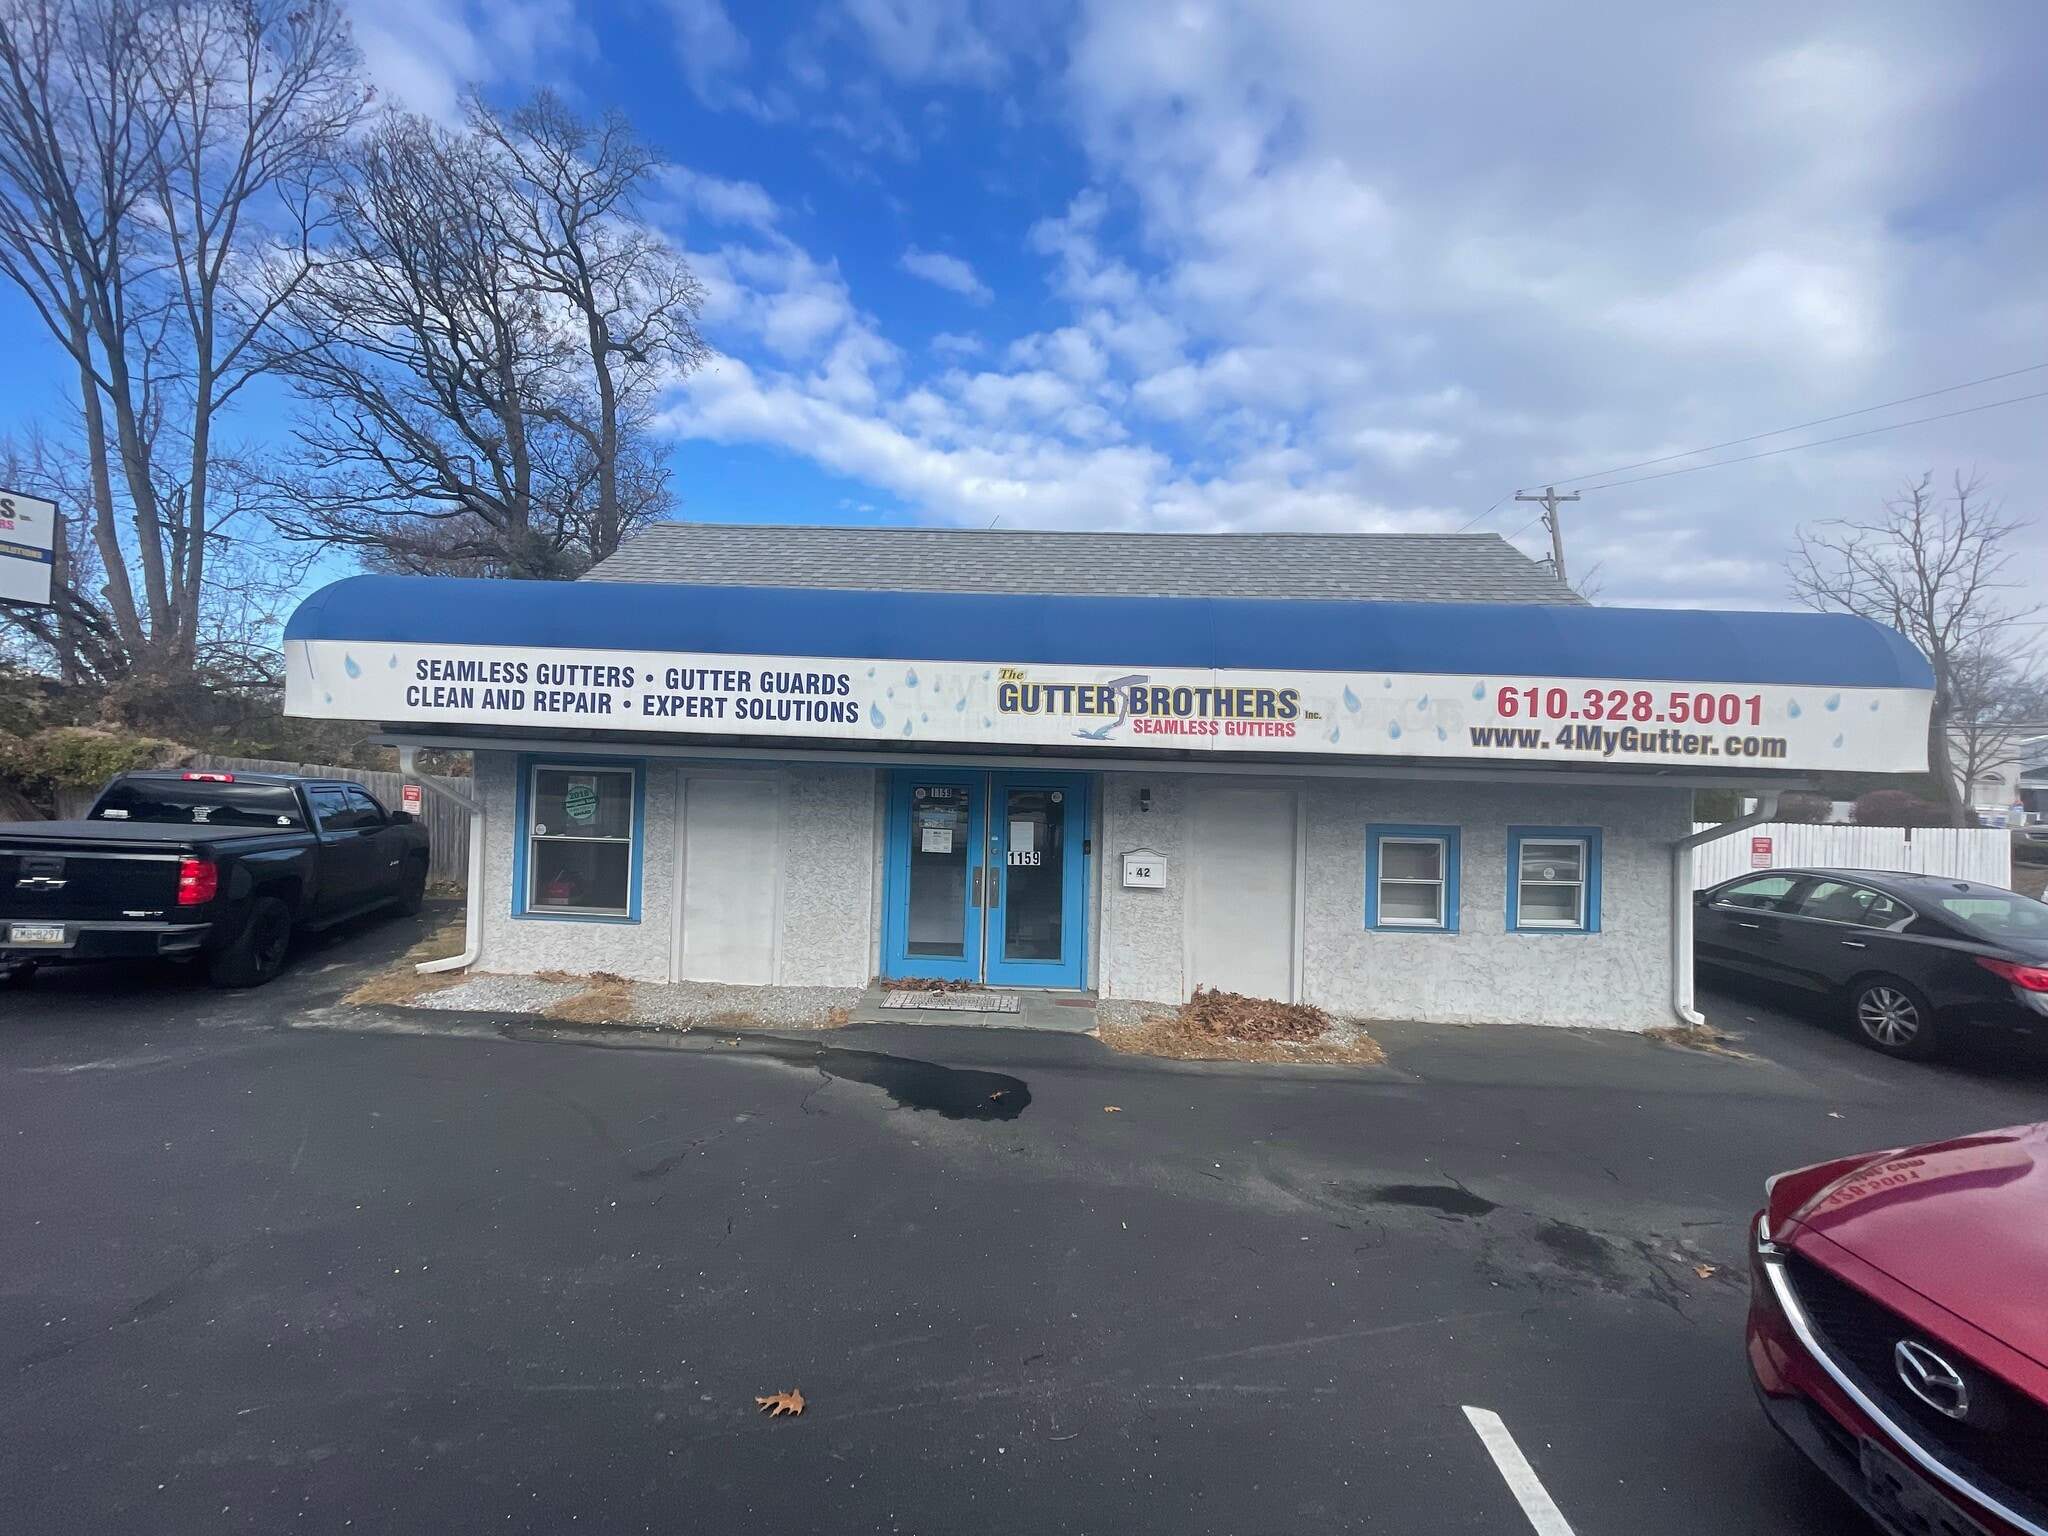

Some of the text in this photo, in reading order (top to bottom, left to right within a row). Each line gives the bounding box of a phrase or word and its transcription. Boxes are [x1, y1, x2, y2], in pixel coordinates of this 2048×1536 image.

[416, 659, 850, 696] SEAMLESS GUTTERS GUTTER GUARDS
[999, 668, 1026, 681] The
[406, 685, 859, 724] CLEAN AND REPAIR EXPERT SOLUTIONS
[998, 682, 1322, 720] GUTTER BROTHERS Inc.
[1497, 686, 1762, 726] 610.328.5001
[1133, 719, 1296, 738] SEAMLESS GUTTERS
[1009, 851, 1040, 865] 1159
[1136, 867, 1150, 877] 42
